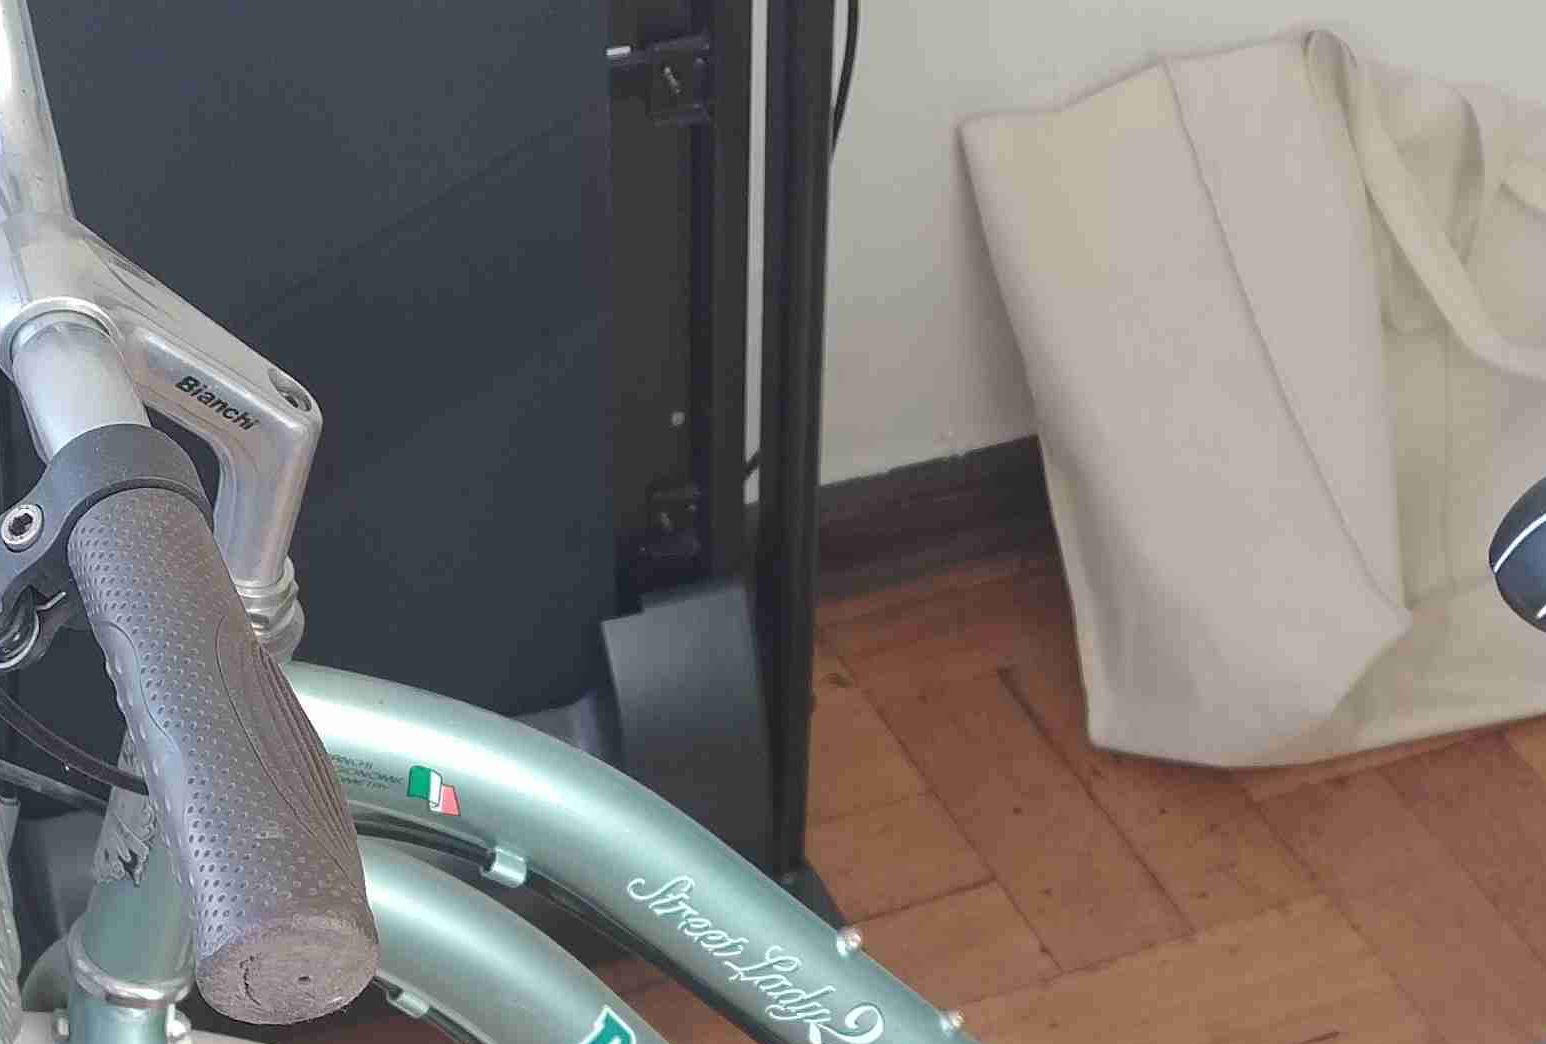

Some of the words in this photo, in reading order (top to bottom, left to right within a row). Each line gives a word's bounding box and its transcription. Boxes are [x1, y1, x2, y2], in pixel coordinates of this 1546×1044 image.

[175, 376, 260, 431] Bianchi
[627, 875, 750, 957] Street
[722, 944, 836, 1024] Lady
